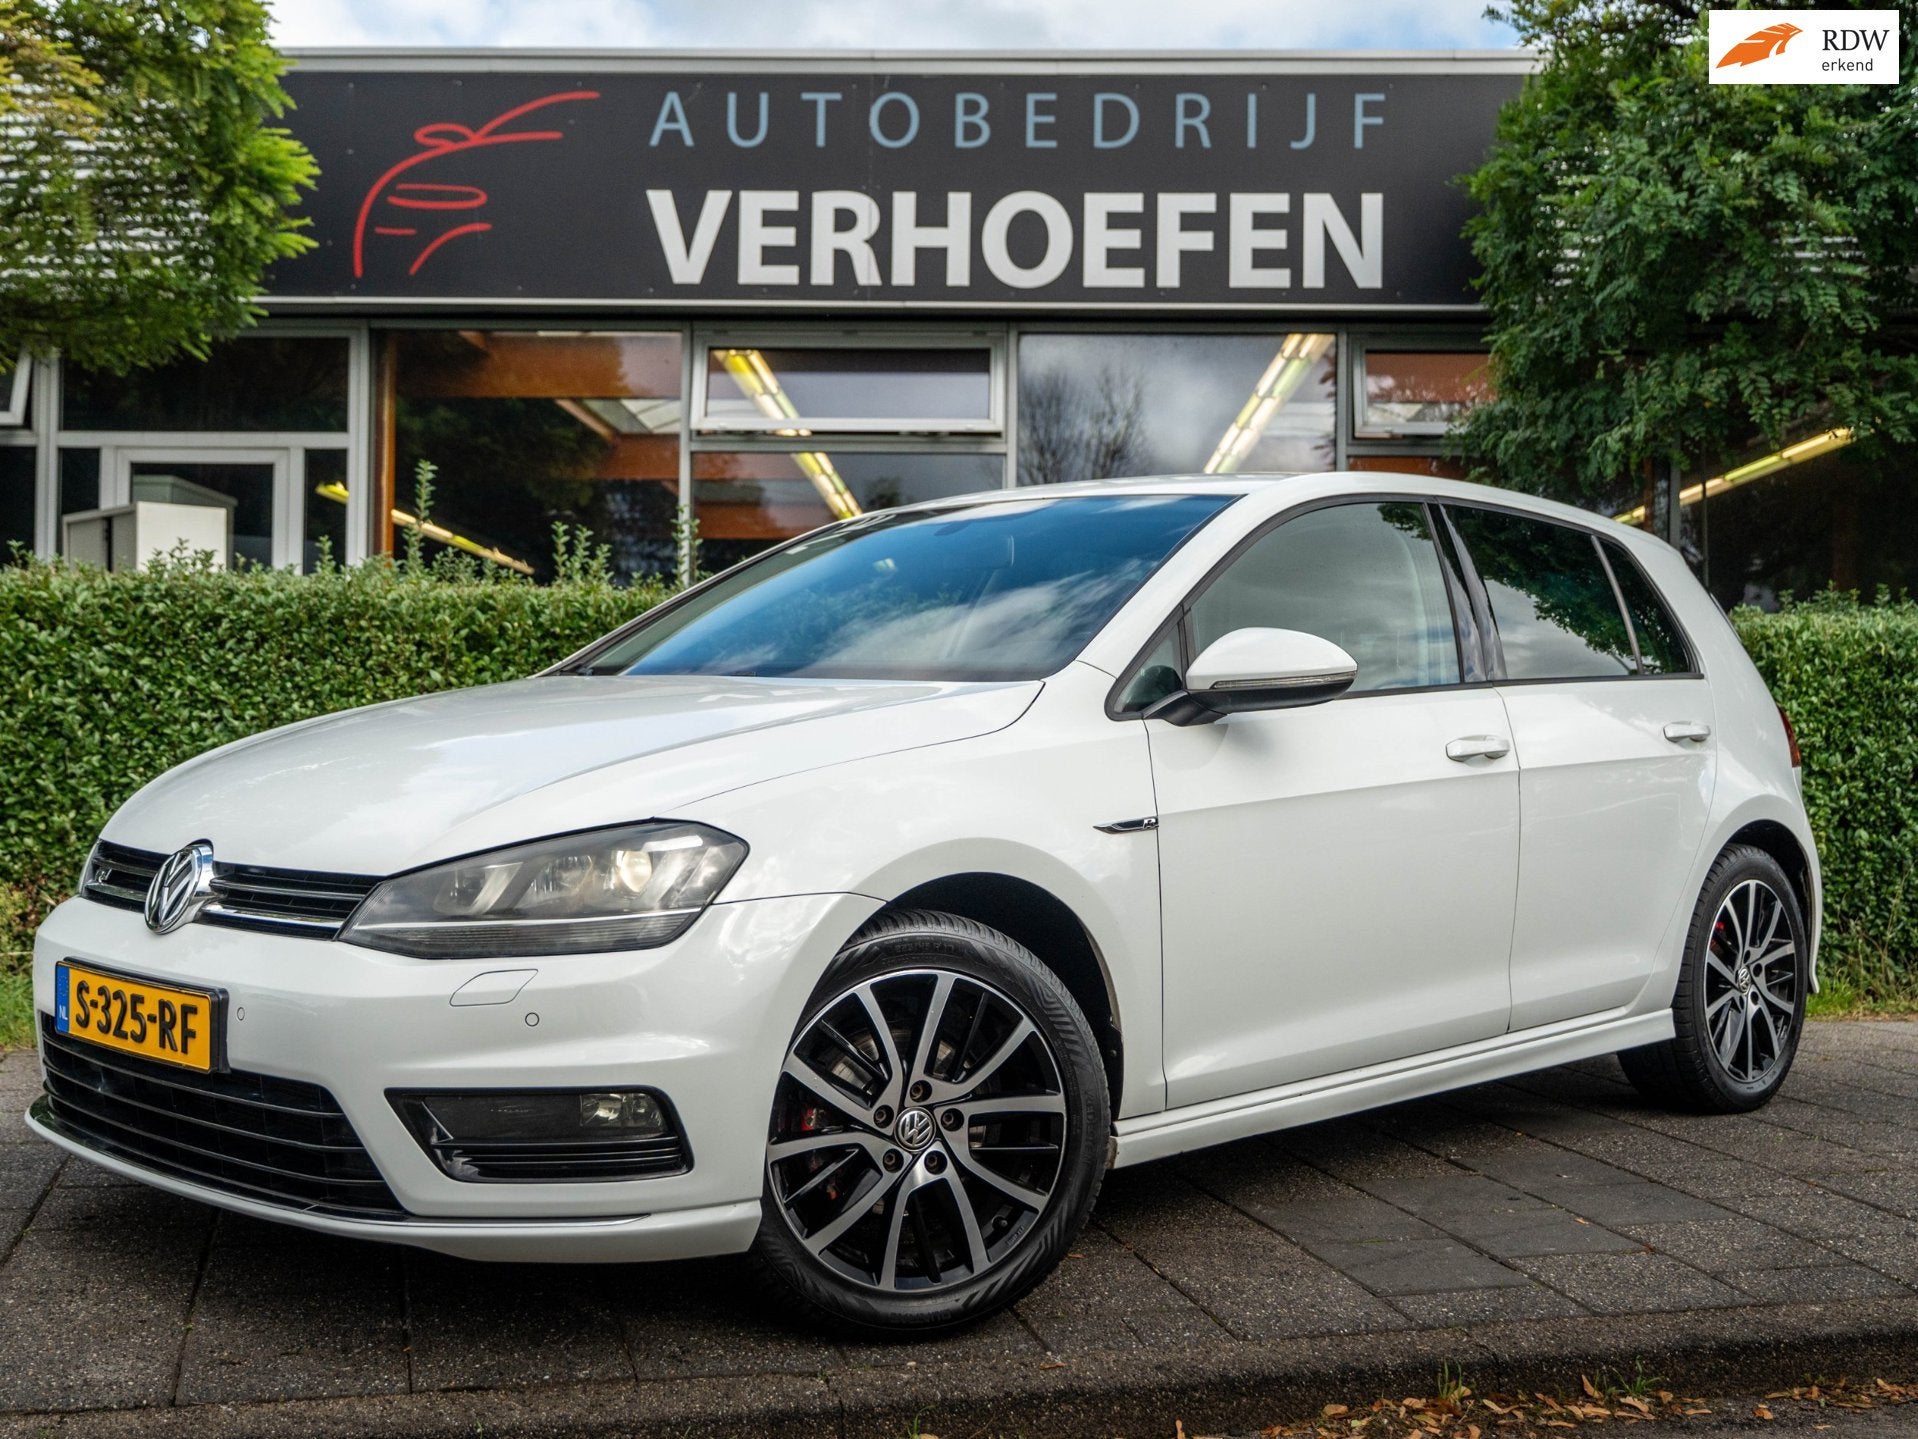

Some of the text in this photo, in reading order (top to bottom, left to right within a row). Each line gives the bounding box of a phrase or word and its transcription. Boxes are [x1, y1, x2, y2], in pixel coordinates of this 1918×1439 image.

[649, 91, 1386, 149] AUTOBEDRIJF
[646, 189, 1384, 290] VERHOEFEN
[59, 1004, 68, 1021] NL
[75, 980, 199, 1055] S-325-RF
